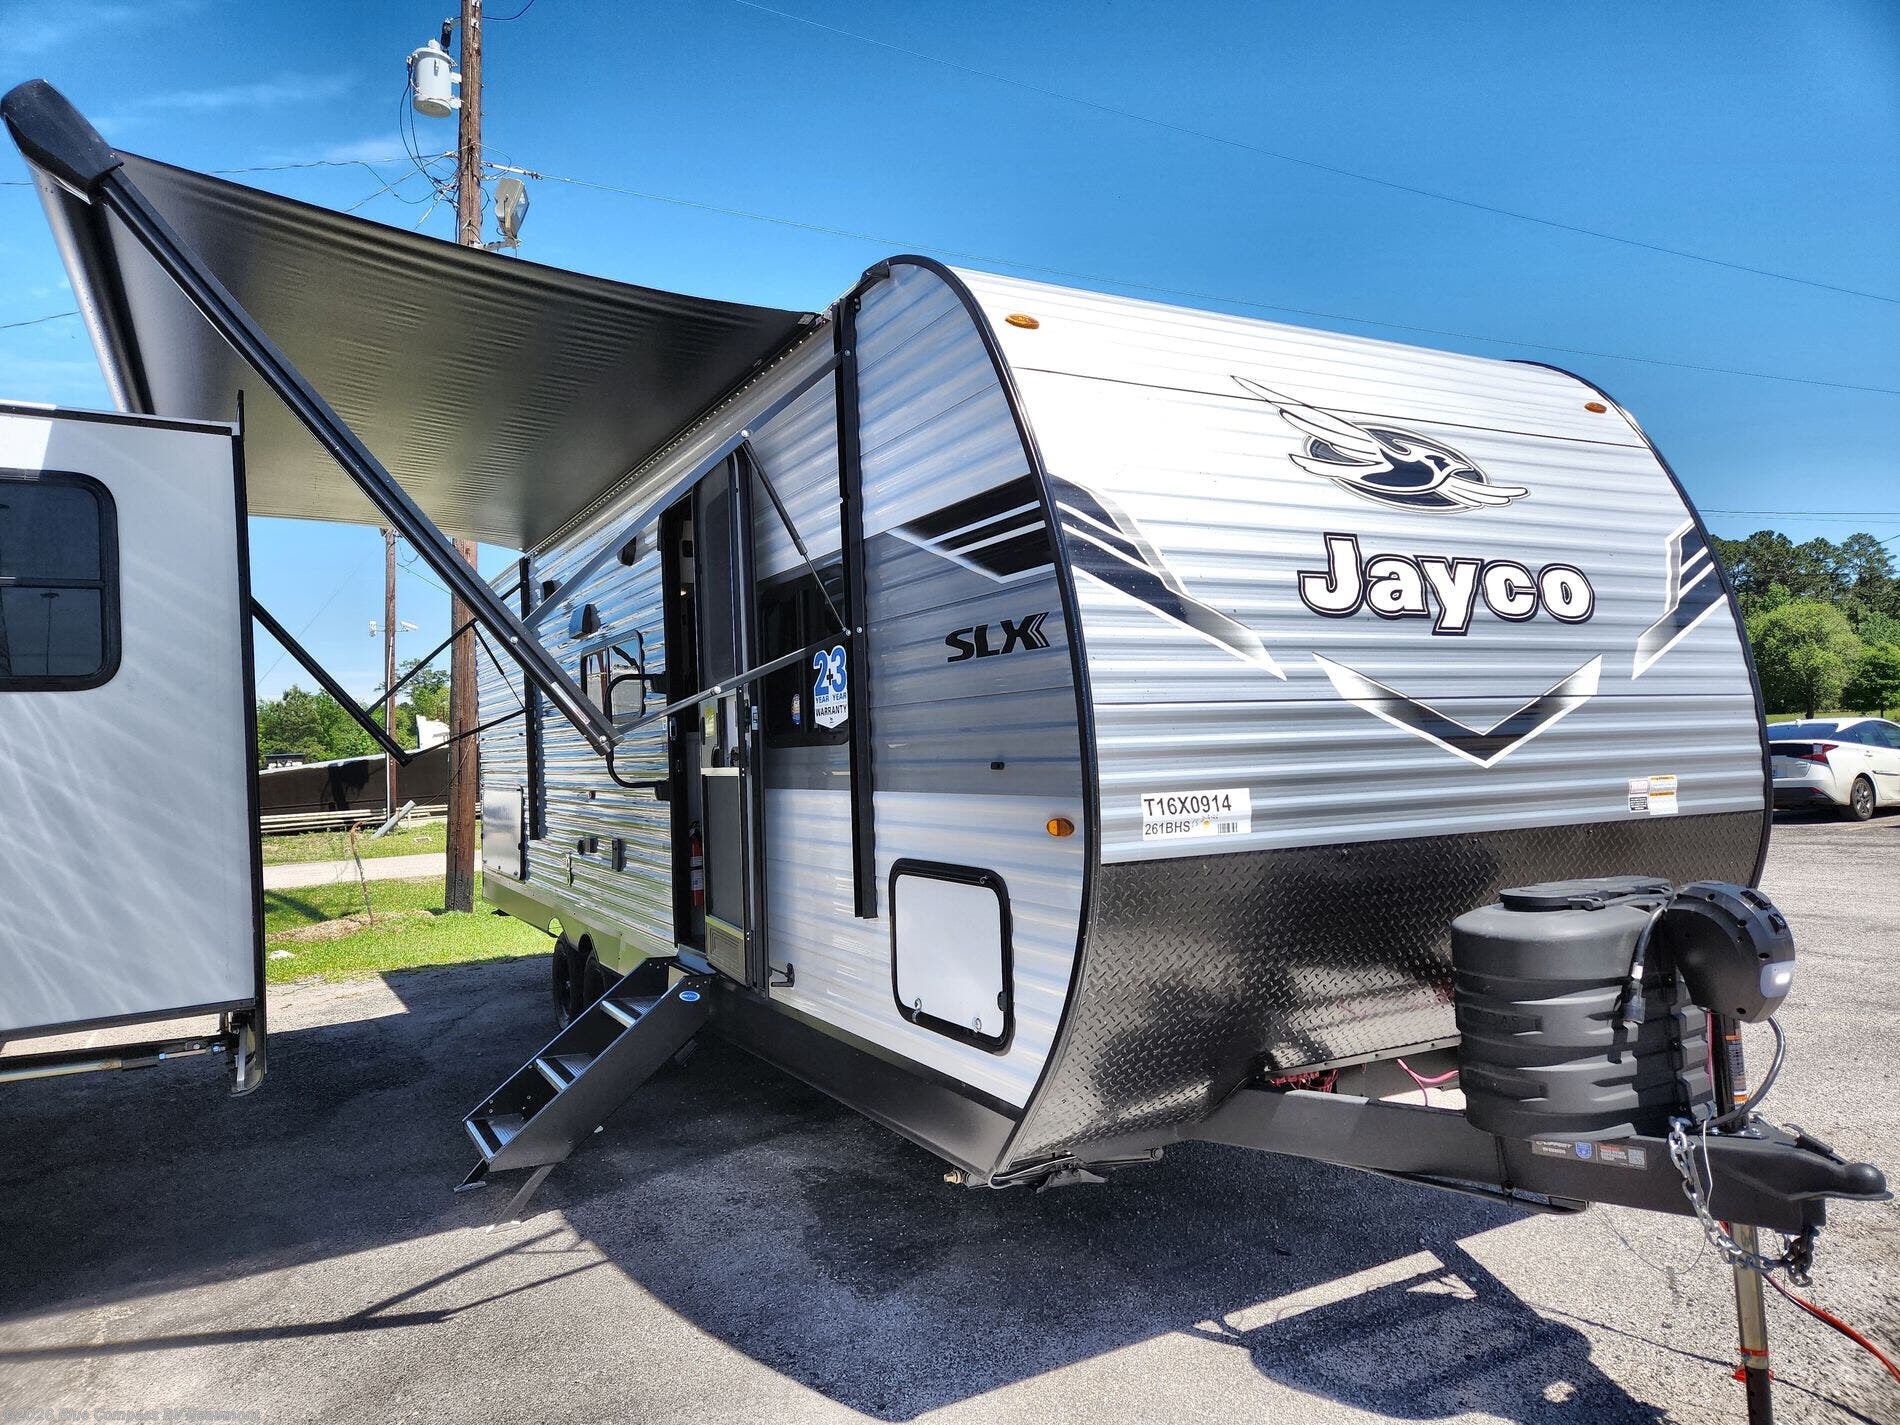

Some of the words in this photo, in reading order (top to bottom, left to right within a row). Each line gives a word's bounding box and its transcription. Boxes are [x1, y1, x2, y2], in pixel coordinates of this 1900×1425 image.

[1297, 532, 1595, 636] Jayco
[945, 612, 1050, 662] SLX
[816, 695, 829, 704] YEAR
[833, 692, 847, 701] YEAR
[816, 704, 847, 717] WARRANTY
[1144, 794, 1232, 816] T16X0914
[1145, 821, 1191, 835] 261BHS
